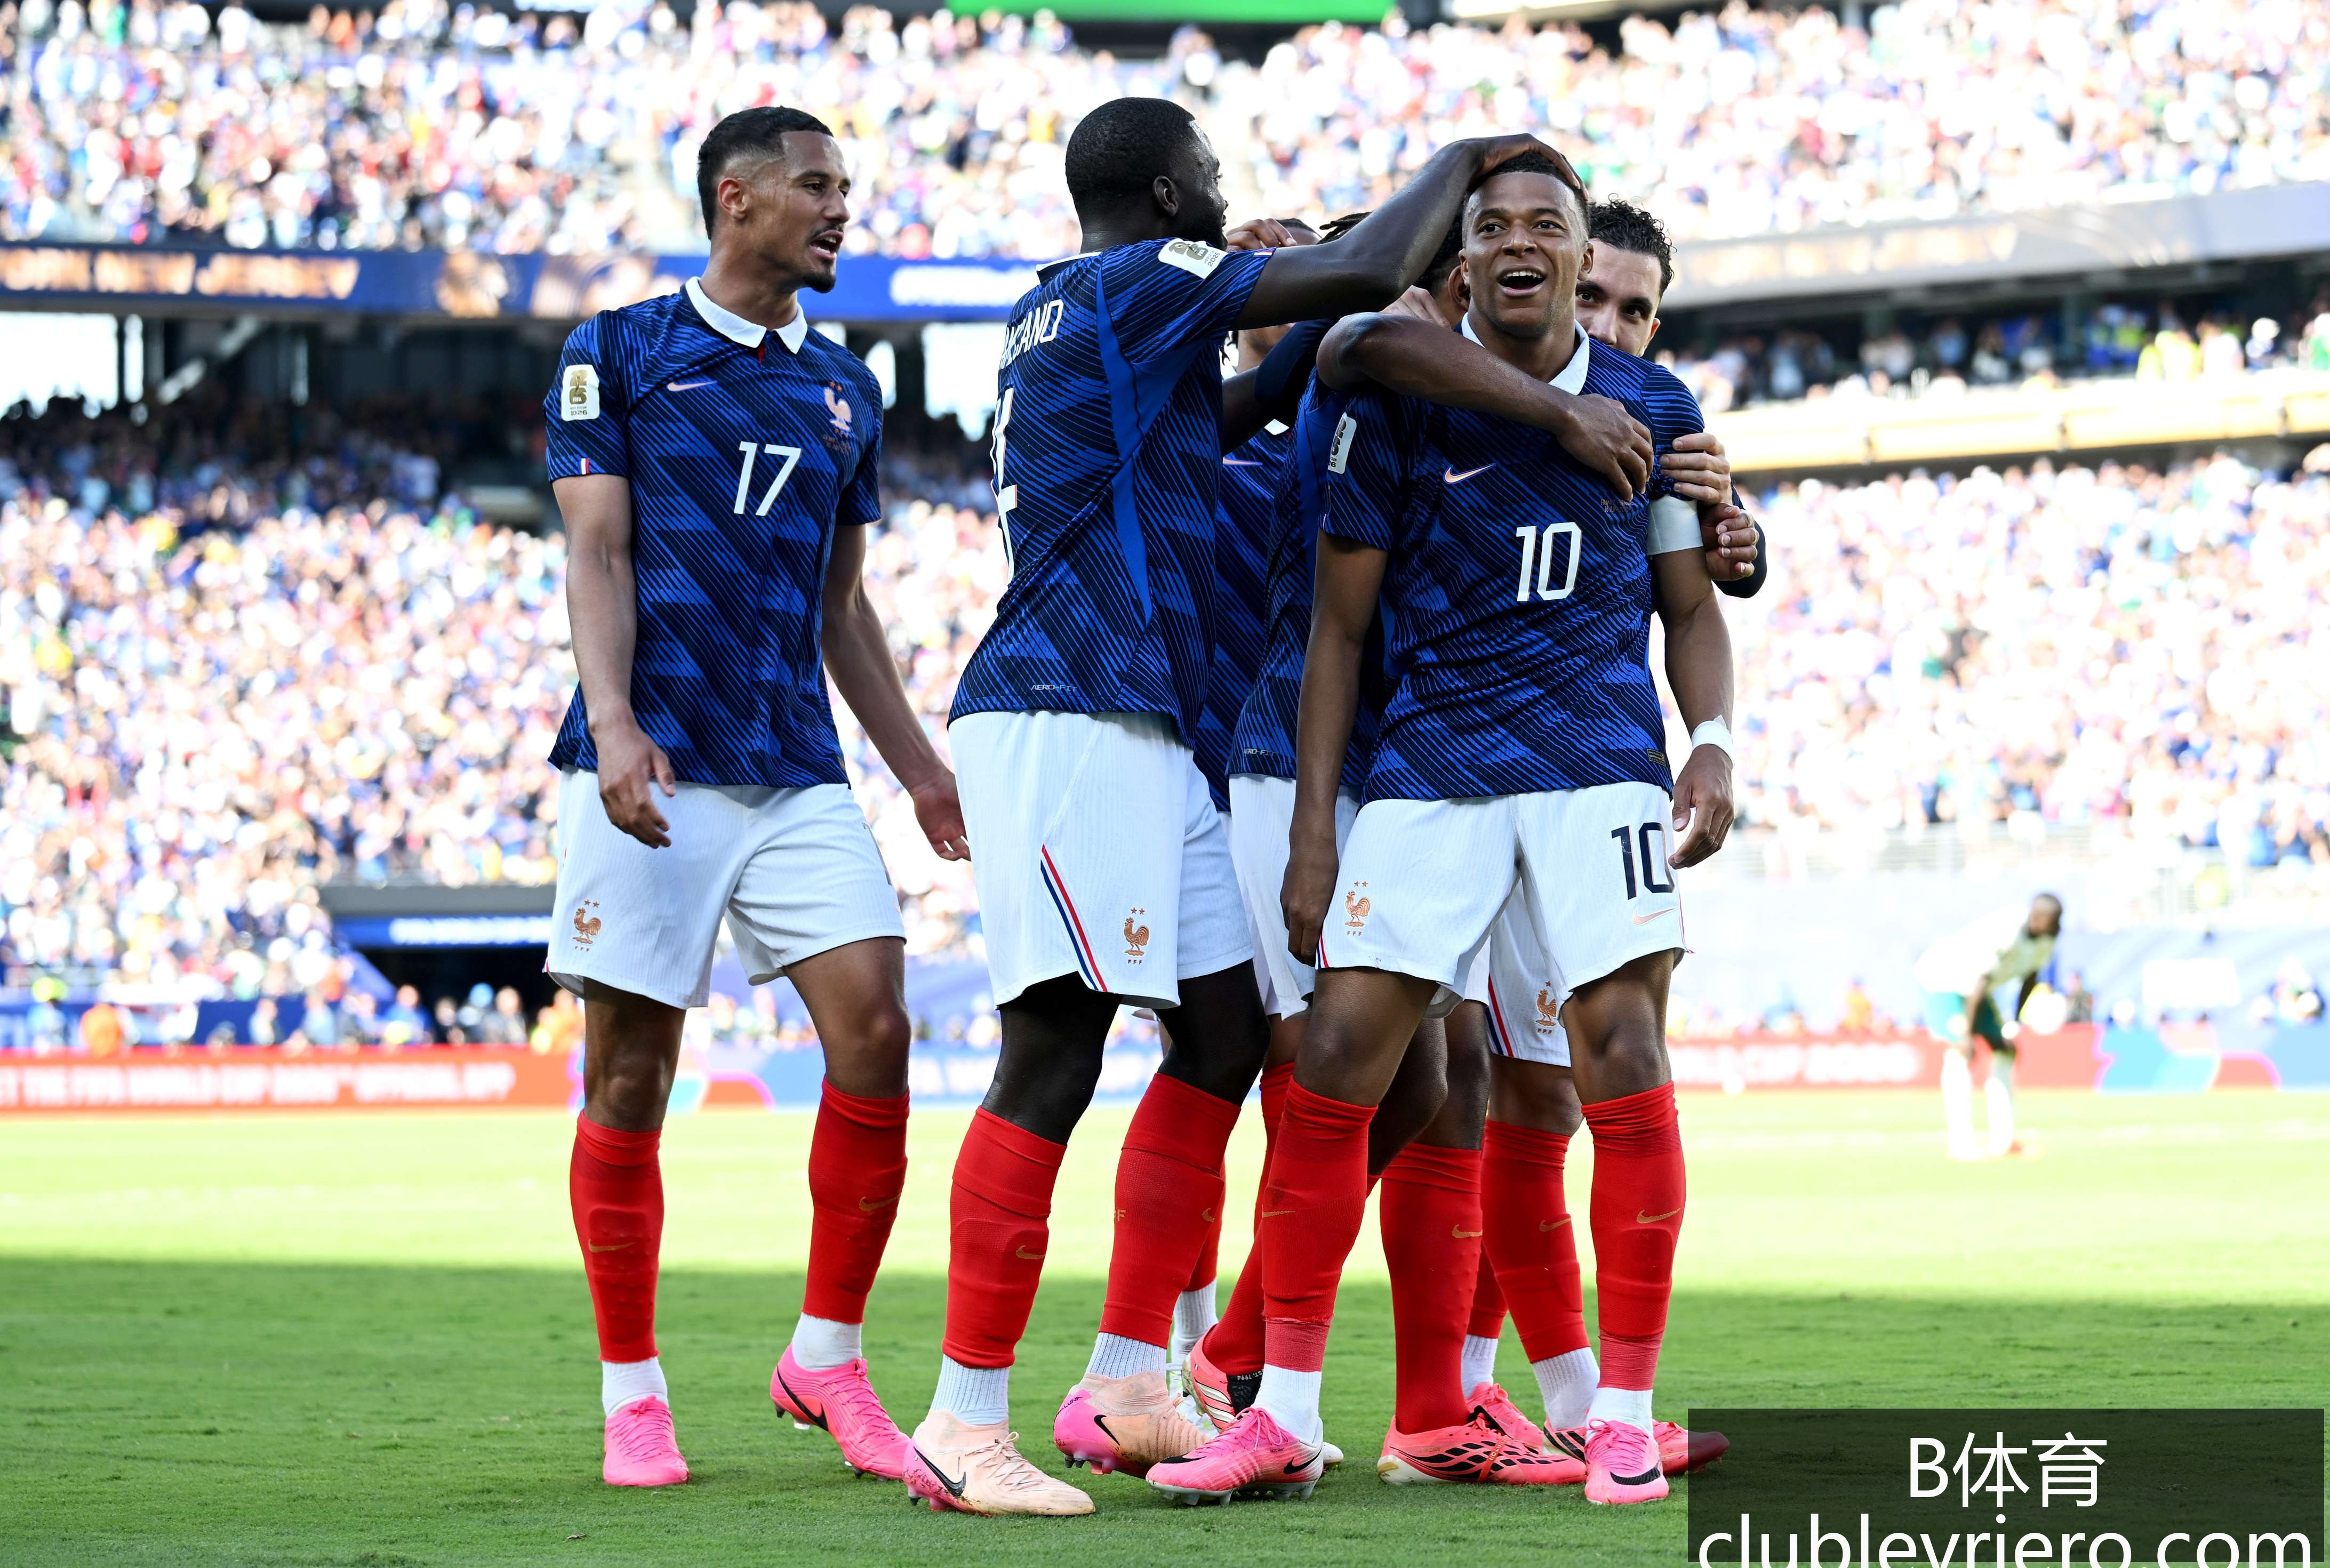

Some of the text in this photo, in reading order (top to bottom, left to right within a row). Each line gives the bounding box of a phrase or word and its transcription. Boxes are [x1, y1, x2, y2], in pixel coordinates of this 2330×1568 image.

[734, 441, 802, 517] 17
[1516, 522, 1583, 602] 10
[1244, 748, 1276, 758] ERO-FIT
[1611, 822, 1676, 900] 10
